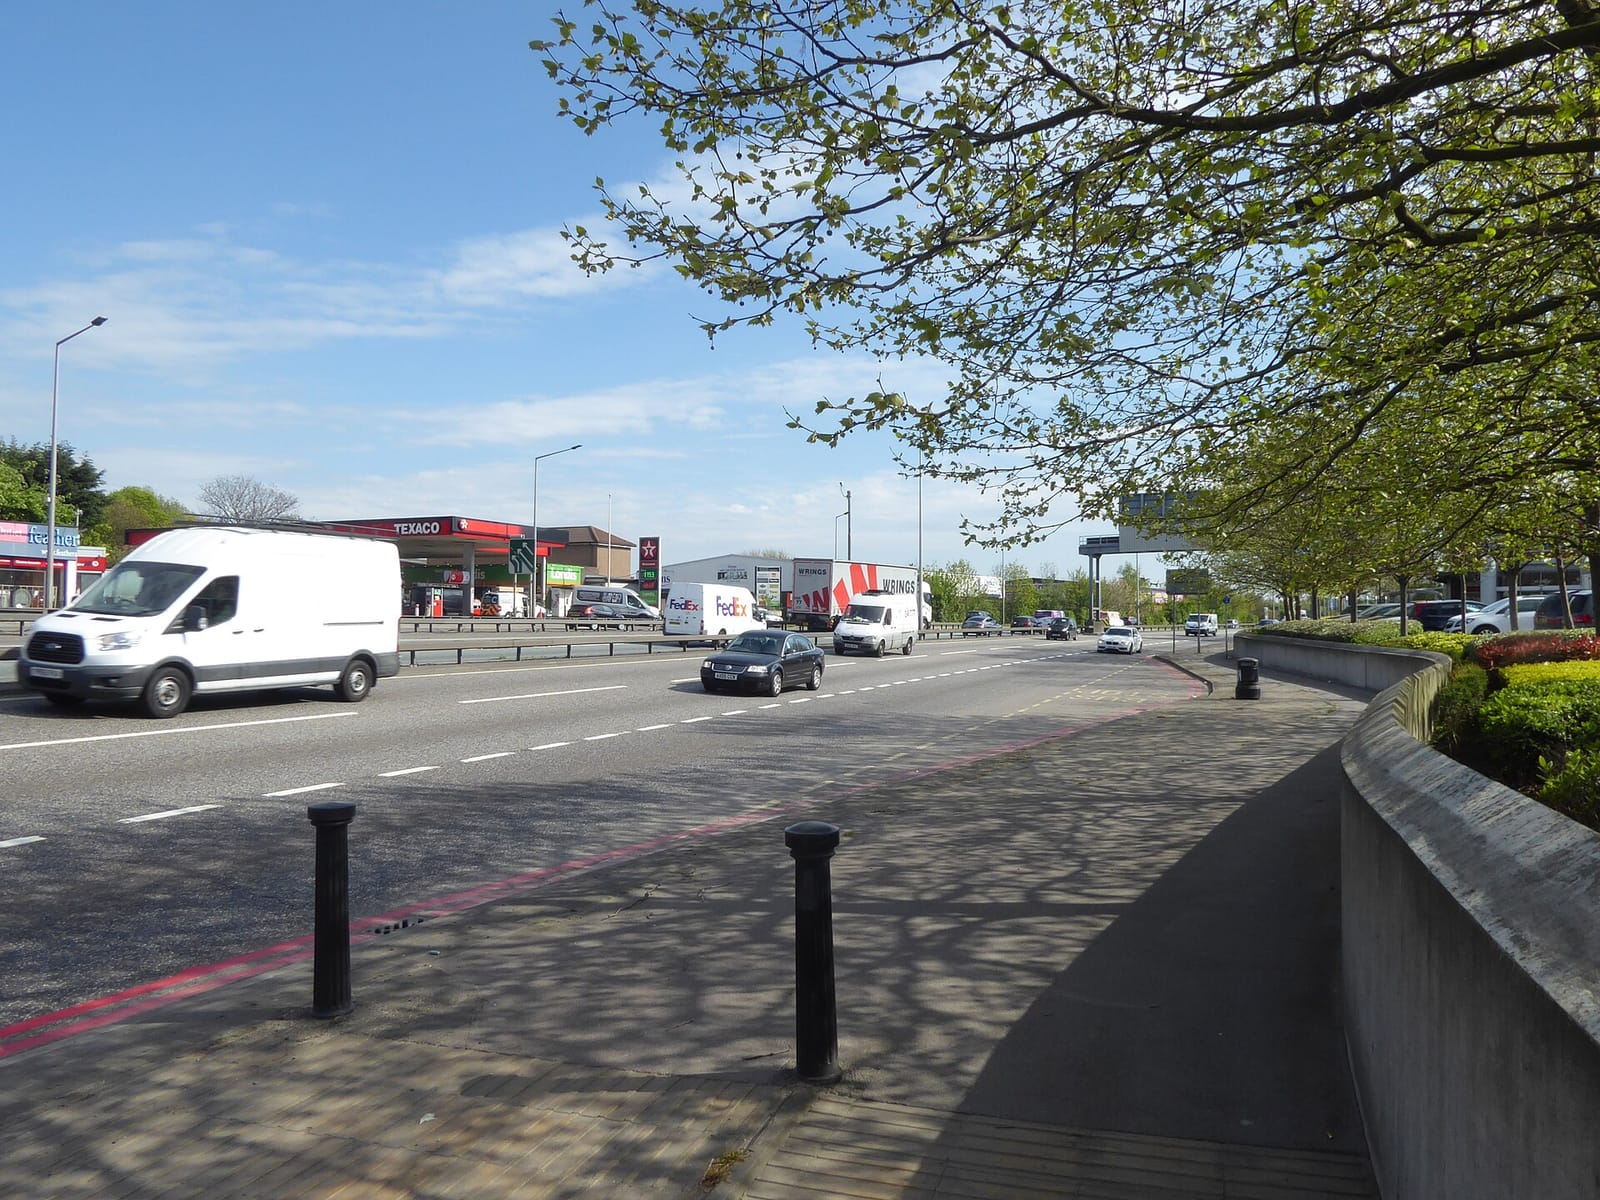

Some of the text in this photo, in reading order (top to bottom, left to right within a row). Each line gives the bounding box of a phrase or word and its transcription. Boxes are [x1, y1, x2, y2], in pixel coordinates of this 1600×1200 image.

[394, 522, 440, 535] TEXACO
[29, 526, 79, 547] feaher
[550, 567, 578, 580] Londis
[798, 567, 827, 576] WRINGS
[882, 578, 916, 594] WRINGS
[669, 599, 699, 611] FedEx
[716, 595, 747, 617] FedEx
